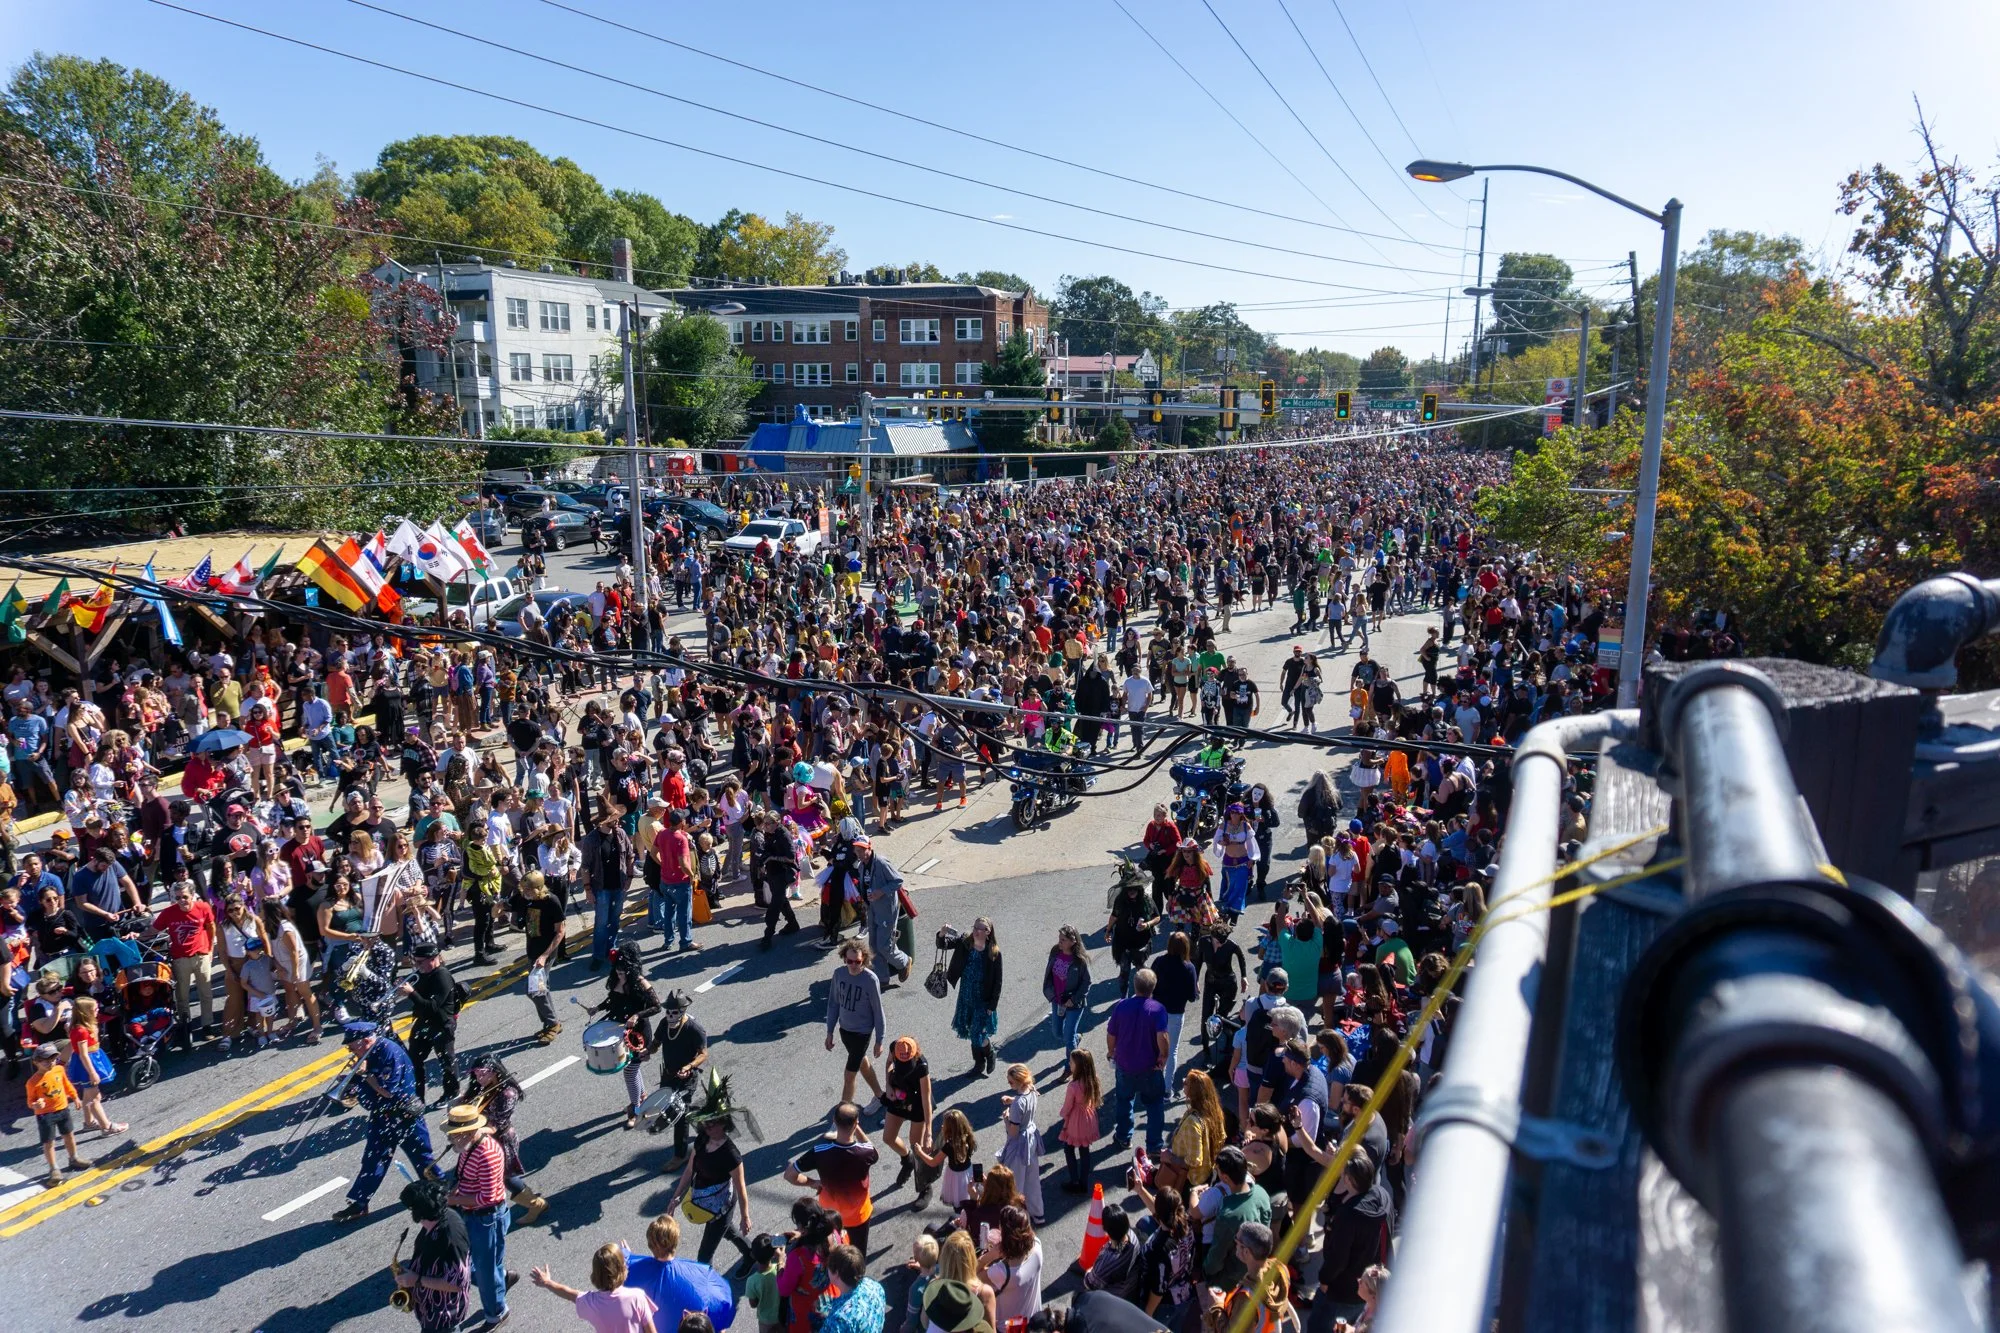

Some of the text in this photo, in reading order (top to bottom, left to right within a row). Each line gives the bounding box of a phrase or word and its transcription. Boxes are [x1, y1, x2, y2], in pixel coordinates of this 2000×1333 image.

[1293, 398, 1326, 406] McLendon
[1599, 649, 1619, 657] marta
[839, 981, 862, 1012] GAP
